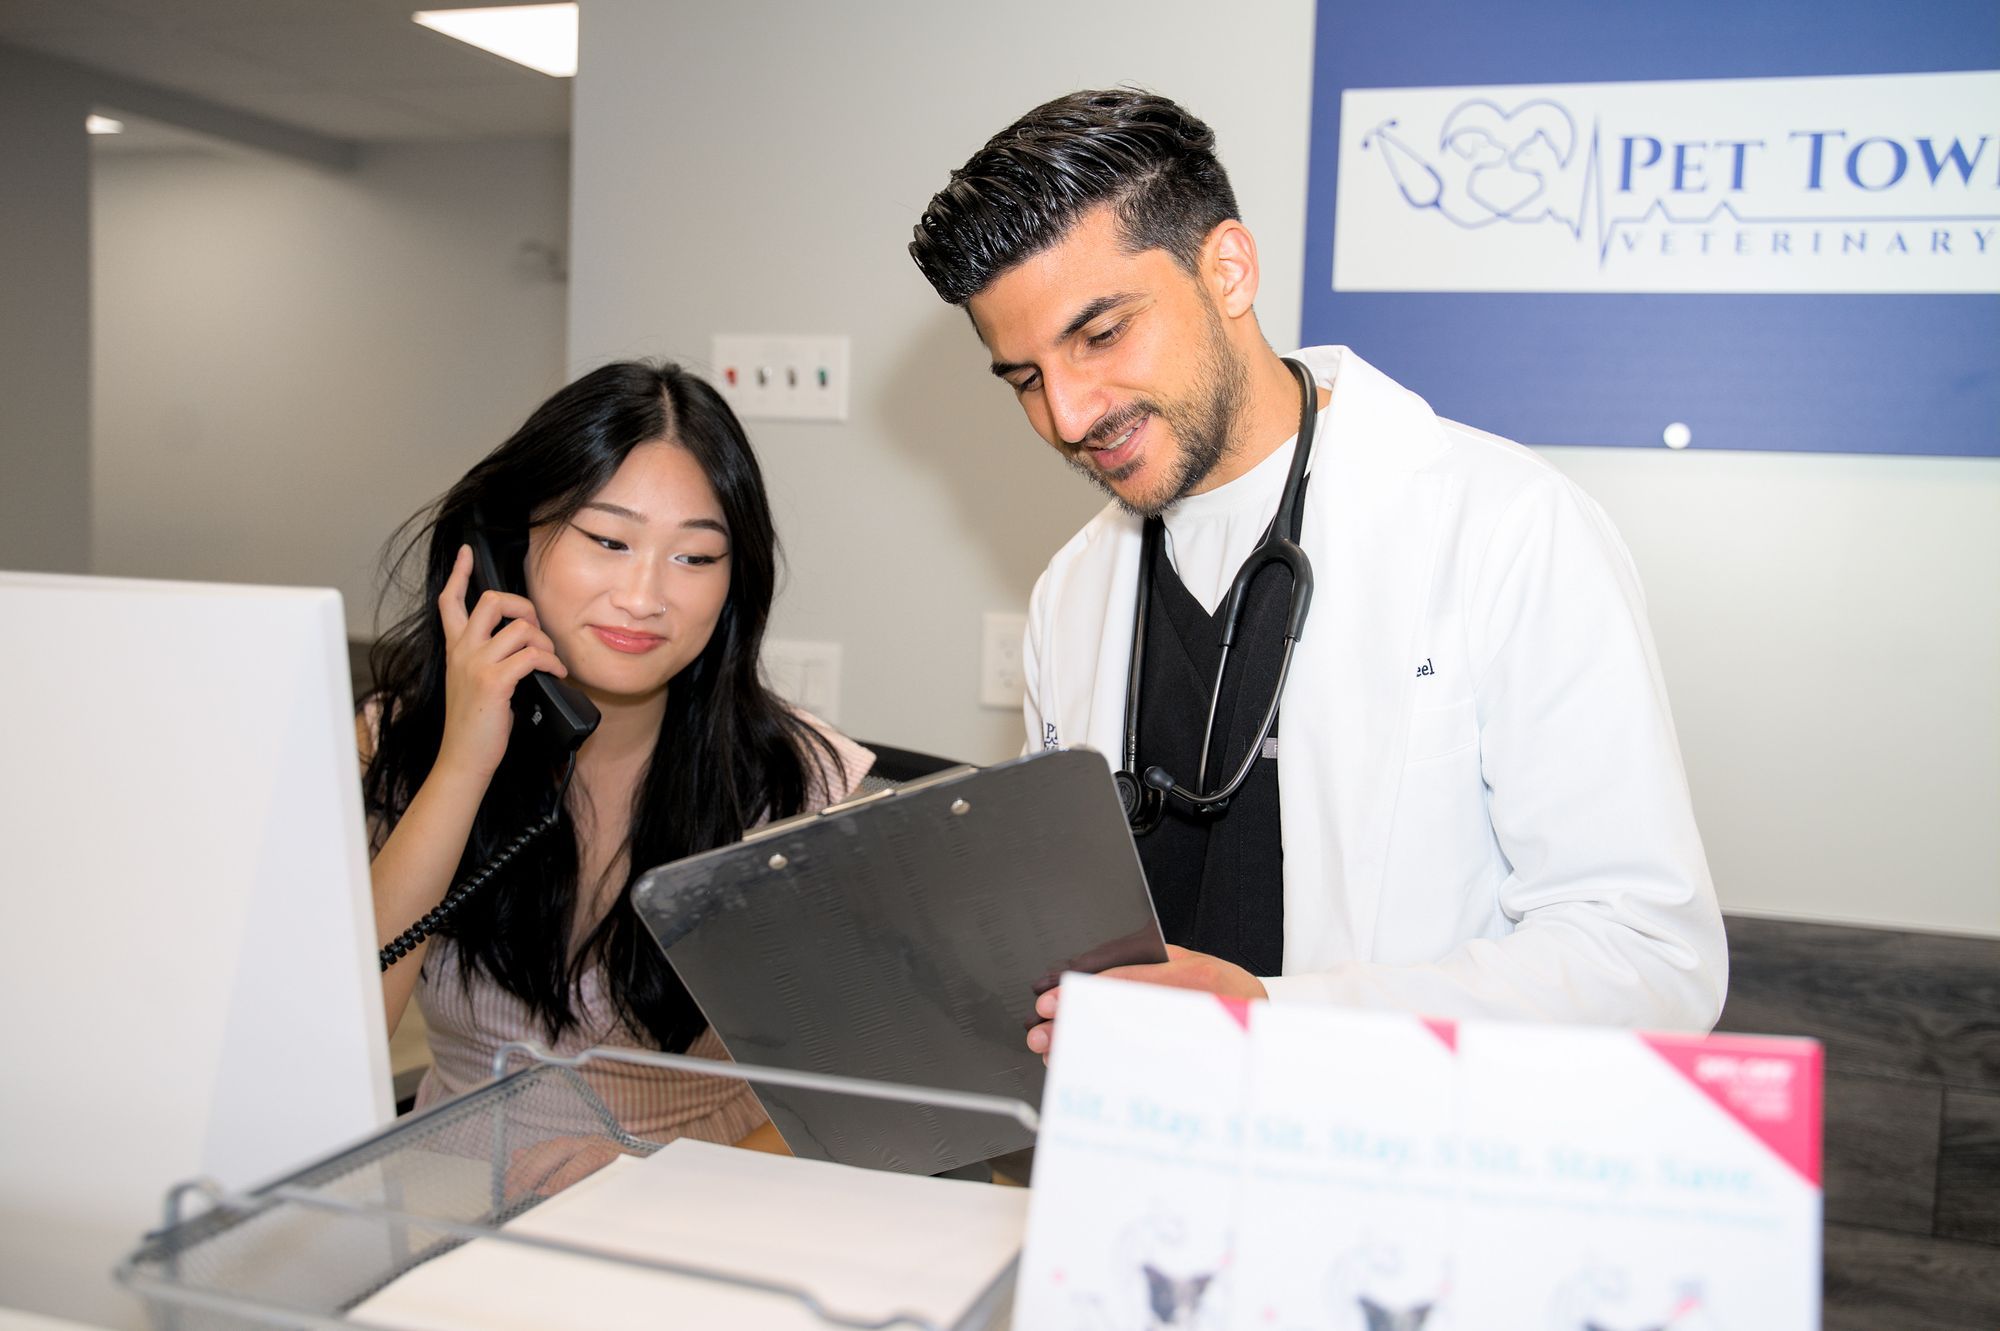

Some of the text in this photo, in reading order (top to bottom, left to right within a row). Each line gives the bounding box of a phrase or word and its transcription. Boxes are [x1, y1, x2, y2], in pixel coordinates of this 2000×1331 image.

[1617, 128, 2000, 193] PET TOW
[1619, 228, 1996, 254] VETERINARY
